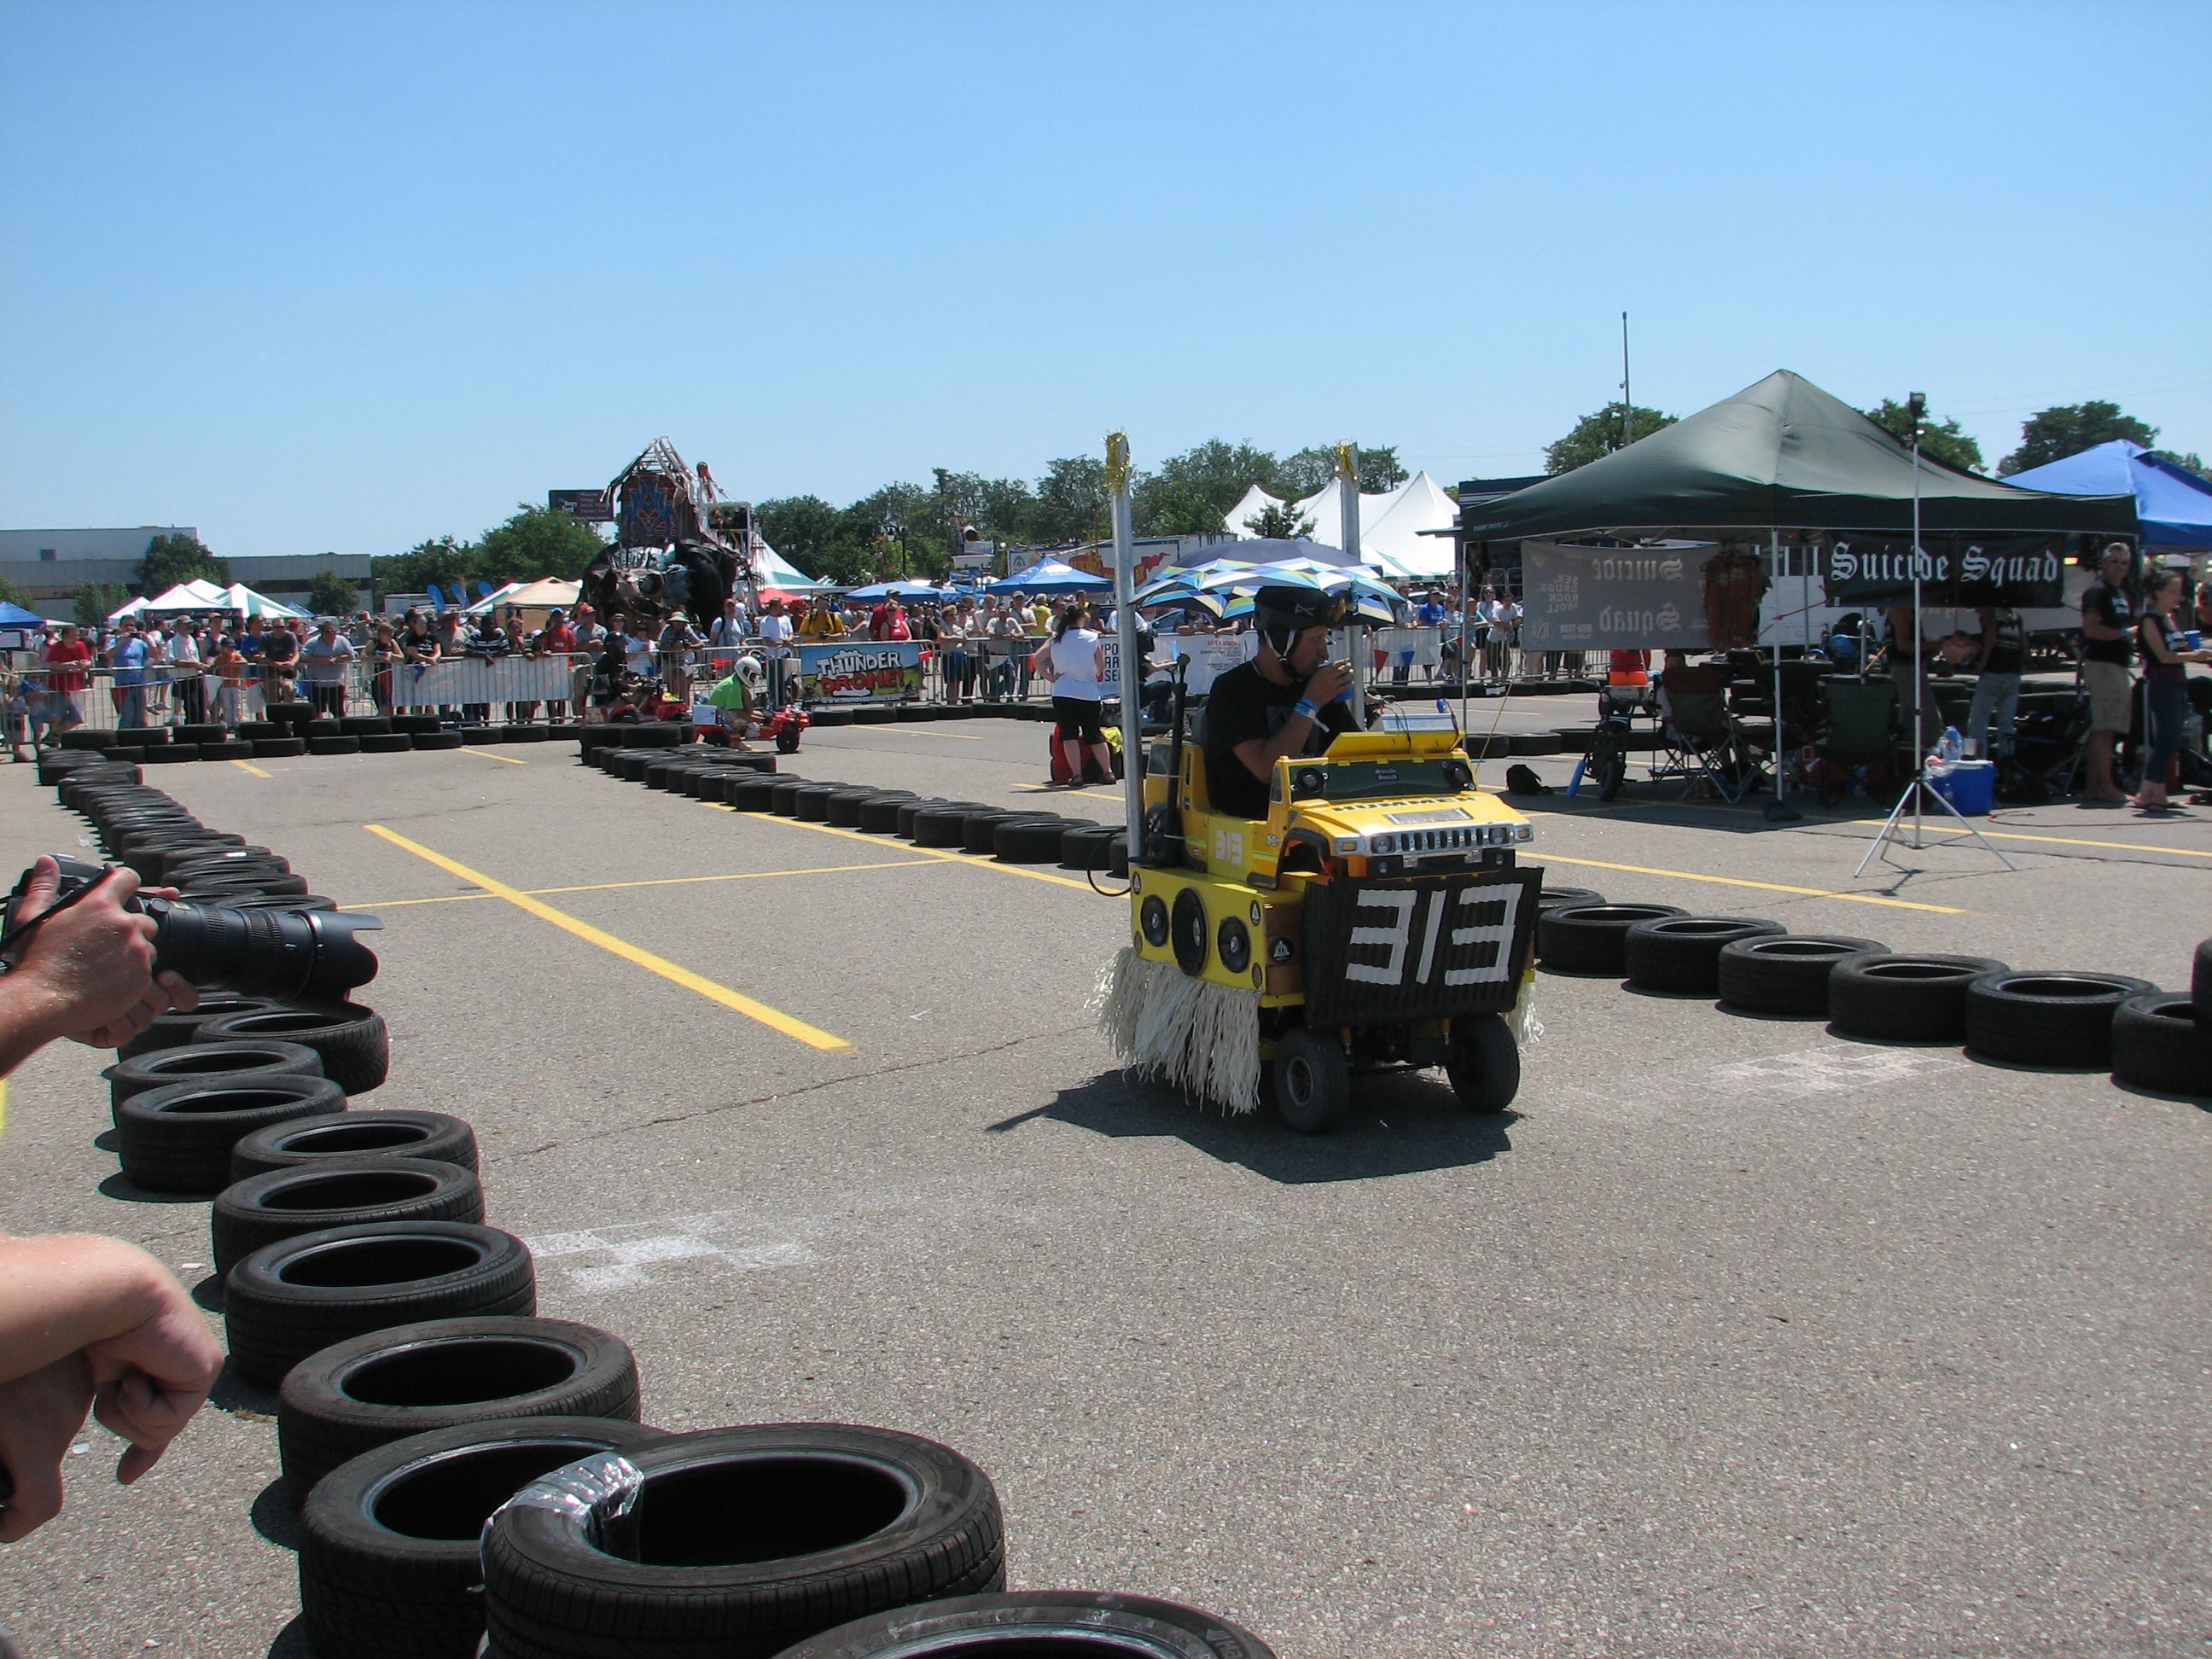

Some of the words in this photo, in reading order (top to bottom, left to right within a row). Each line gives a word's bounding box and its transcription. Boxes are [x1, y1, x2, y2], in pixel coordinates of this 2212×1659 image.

[1831, 541, 1950, 582] Suicide
[1960, 544, 2059, 589] Squad
[817, 651, 902, 676] THUNDER
[820, 669, 905, 693] DROME!
[1215, 830, 1243, 864] 313
[1344, 882, 1524, 987] 313
